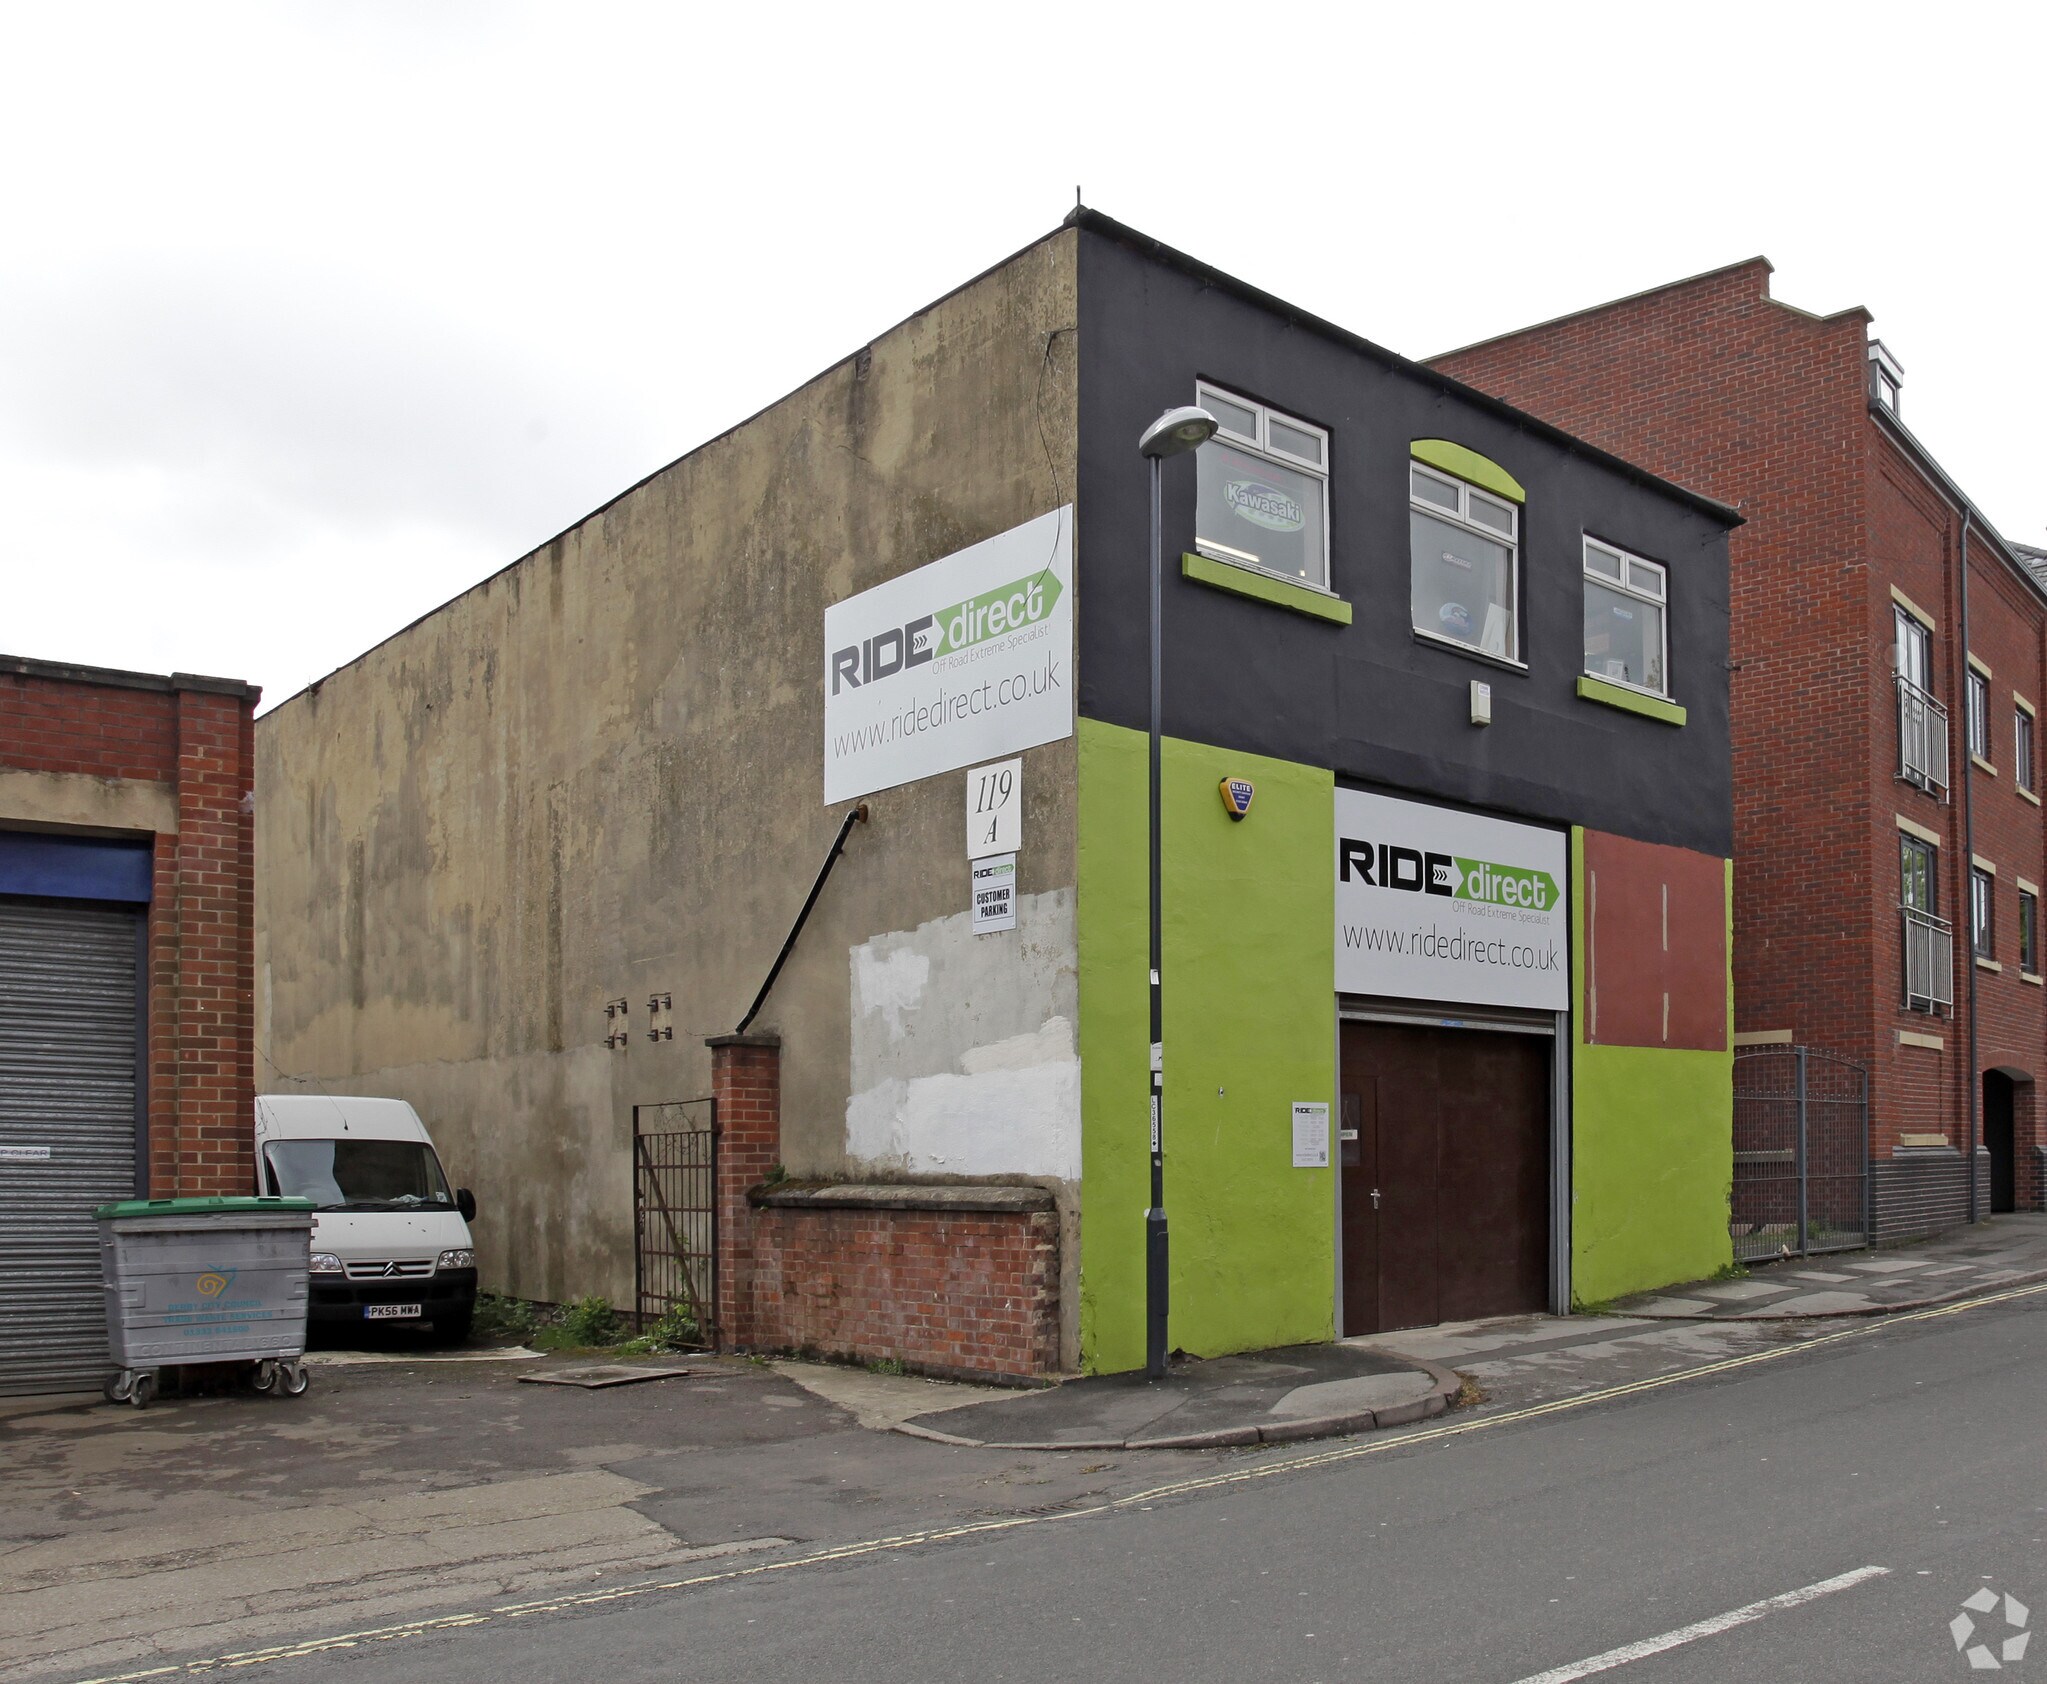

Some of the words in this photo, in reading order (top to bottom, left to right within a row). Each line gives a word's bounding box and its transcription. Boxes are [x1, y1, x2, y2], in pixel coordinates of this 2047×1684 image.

[1226, 482, 1300, 523] Kawasaki
[832, 614, 933, 696] RIDE
[948, 581, 1043, 649] direct
[932, 657, 947, 675] Off
[949, 654, 968, 669] Road
[970, 643, 1005, 662] Extreme
[1007, 624, 1049, 651] Specialist
[834, 650, 1060, 758] www.ridedirect.co.uk
[975, 769, 1012, 814] 119
[1231, 783, 1250, 792] ELITE
[983, 814, 998, 844] A
[974, 868, 993, 879] RIDE
[1340, 837, 1452, 897] RIDE
[1467, 863, 1546, 909] direct
[977, 889, 1010, 904] CUSTOMER
[981, 903, 1007, 918] PARKING
[1452, 900, 1465, 912] Off
[1467, 903, 1486, 916] Road
[1487, 906, 1517, 920] Extreme
[1518, 911, 1550, 925] Specialist
[1343, 923, 1559, 972] www.ridedirect.co.uk
[371, 1306, 398, 1316] PK56
[400, 1305, 419, 1315] MWA
